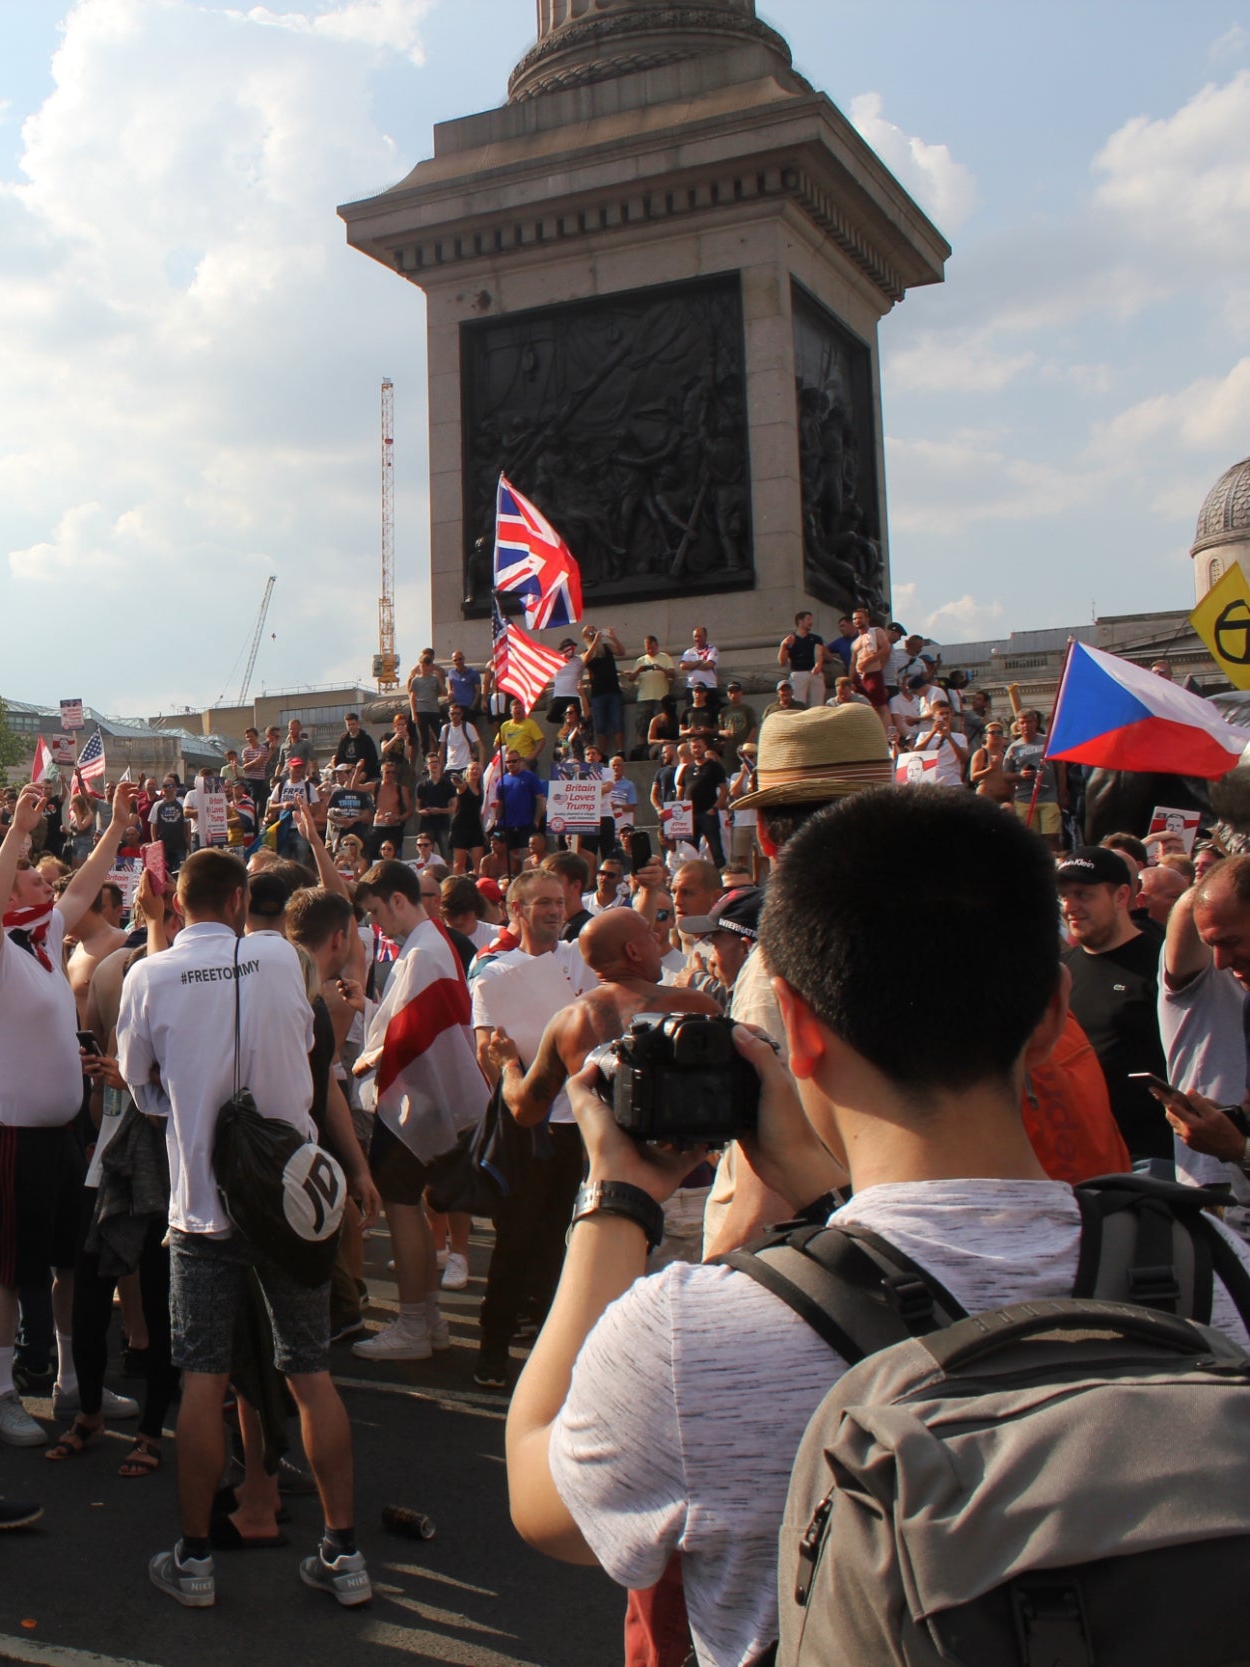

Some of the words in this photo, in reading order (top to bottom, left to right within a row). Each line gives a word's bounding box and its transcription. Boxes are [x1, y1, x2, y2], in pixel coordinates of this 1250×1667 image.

[282, 787, 305, 795] FREE
[565, 783, 596, 792] Britain
[569, 793, 596, 801] Loves
[567, 802, 595, 811] Trump
[719, 917, 758, 938] INTERNATI
[180, 959, 260, 985] #FREETOMMY
[301, 1151, 339, 1235] JD
